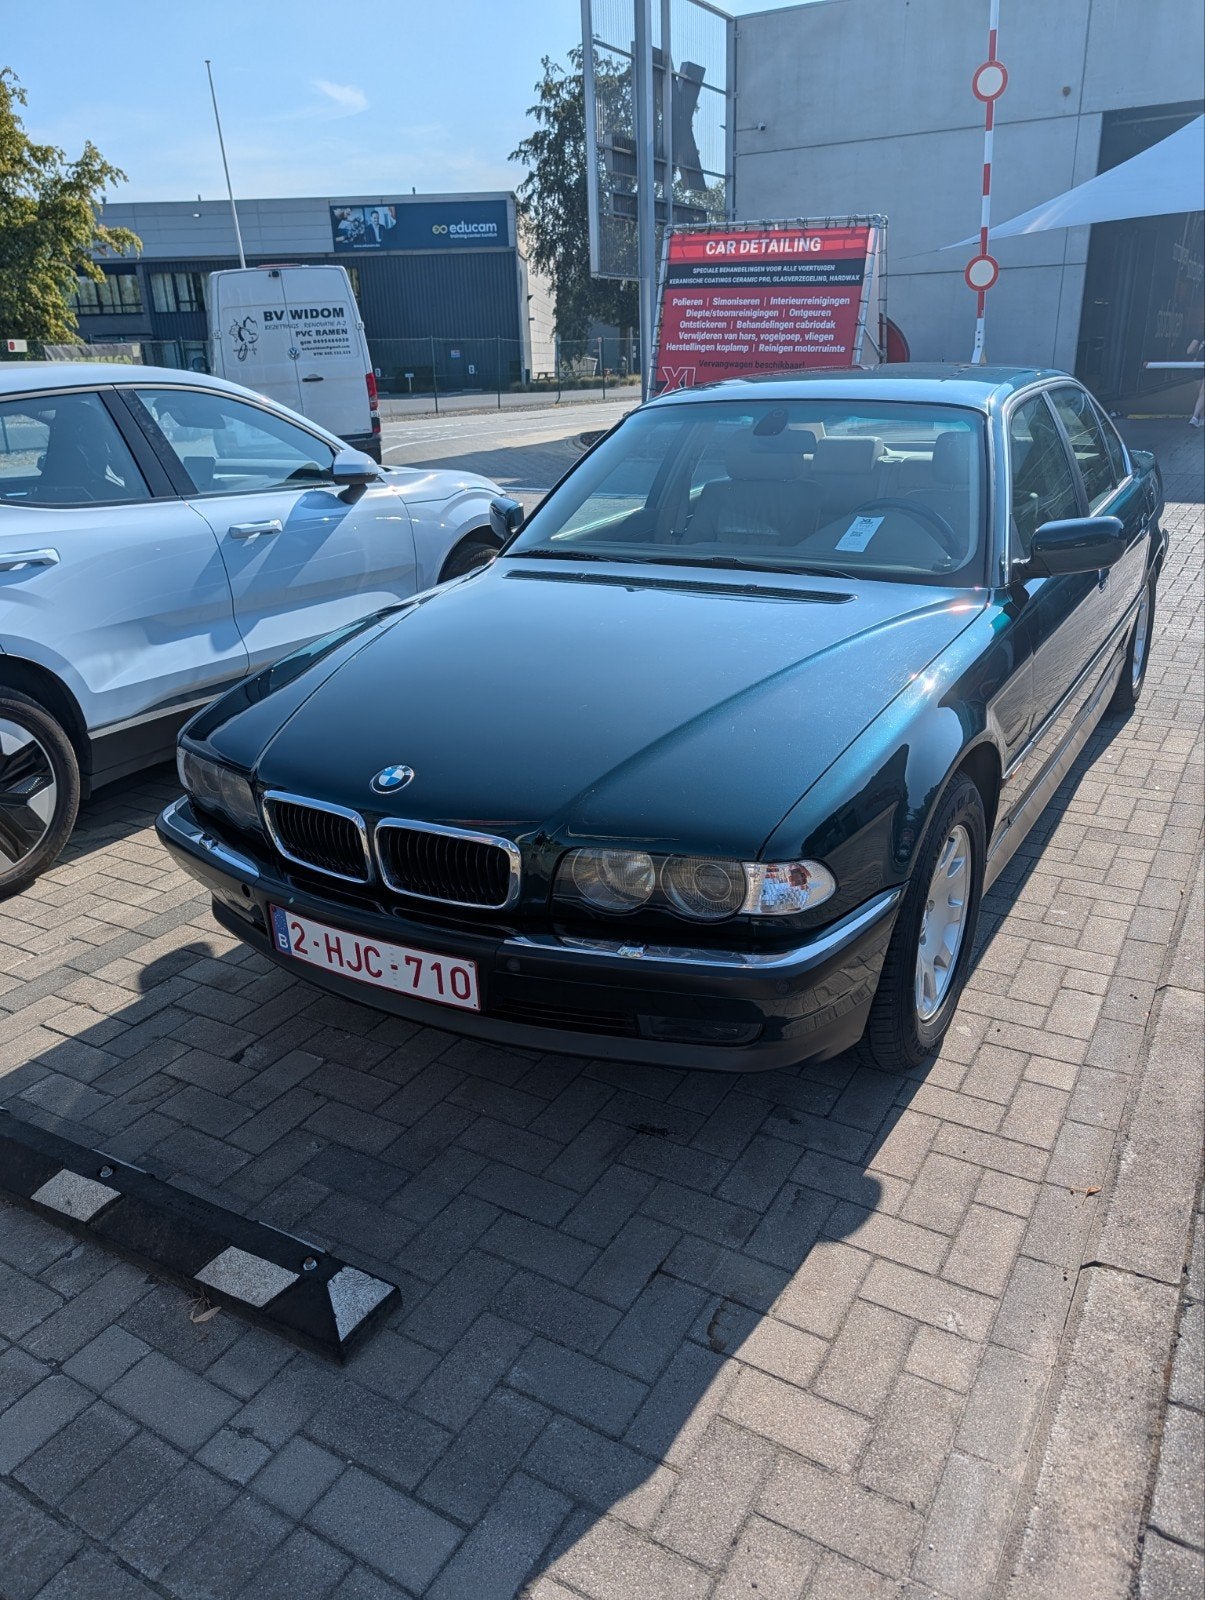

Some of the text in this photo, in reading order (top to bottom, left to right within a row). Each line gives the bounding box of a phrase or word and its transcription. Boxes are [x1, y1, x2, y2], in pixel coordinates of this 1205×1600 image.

[450, 220, 498, 232] educam
[706, 238, 821, 255] CAR DETAILING
[672, 296, 850, 307] Polieren Simoniseren Interieurreinigingen
[263, 307, 345, 321] BV WIDOM
[686, 308, 832, 318] Diepte/stoomreinigingen Ontgeuren
[680, 320, 836, 330] Ontstickeren Behandelingen cabriodak
[679, 332, 723, 341] Verwijderen
[739, 332, 758, 342] hars,
[760, 332, 803, 343] vogelpoep,
[804, 332, 834, 342] vliegen
[666, 343, 846, 354] Herstellingen koplamp Reinigen motorruimte
[698, 360, 753, 369] Vervangwagen
[278, 934, 289, 949] B
[290, 921, 471, 1000] 2-HJC-710
